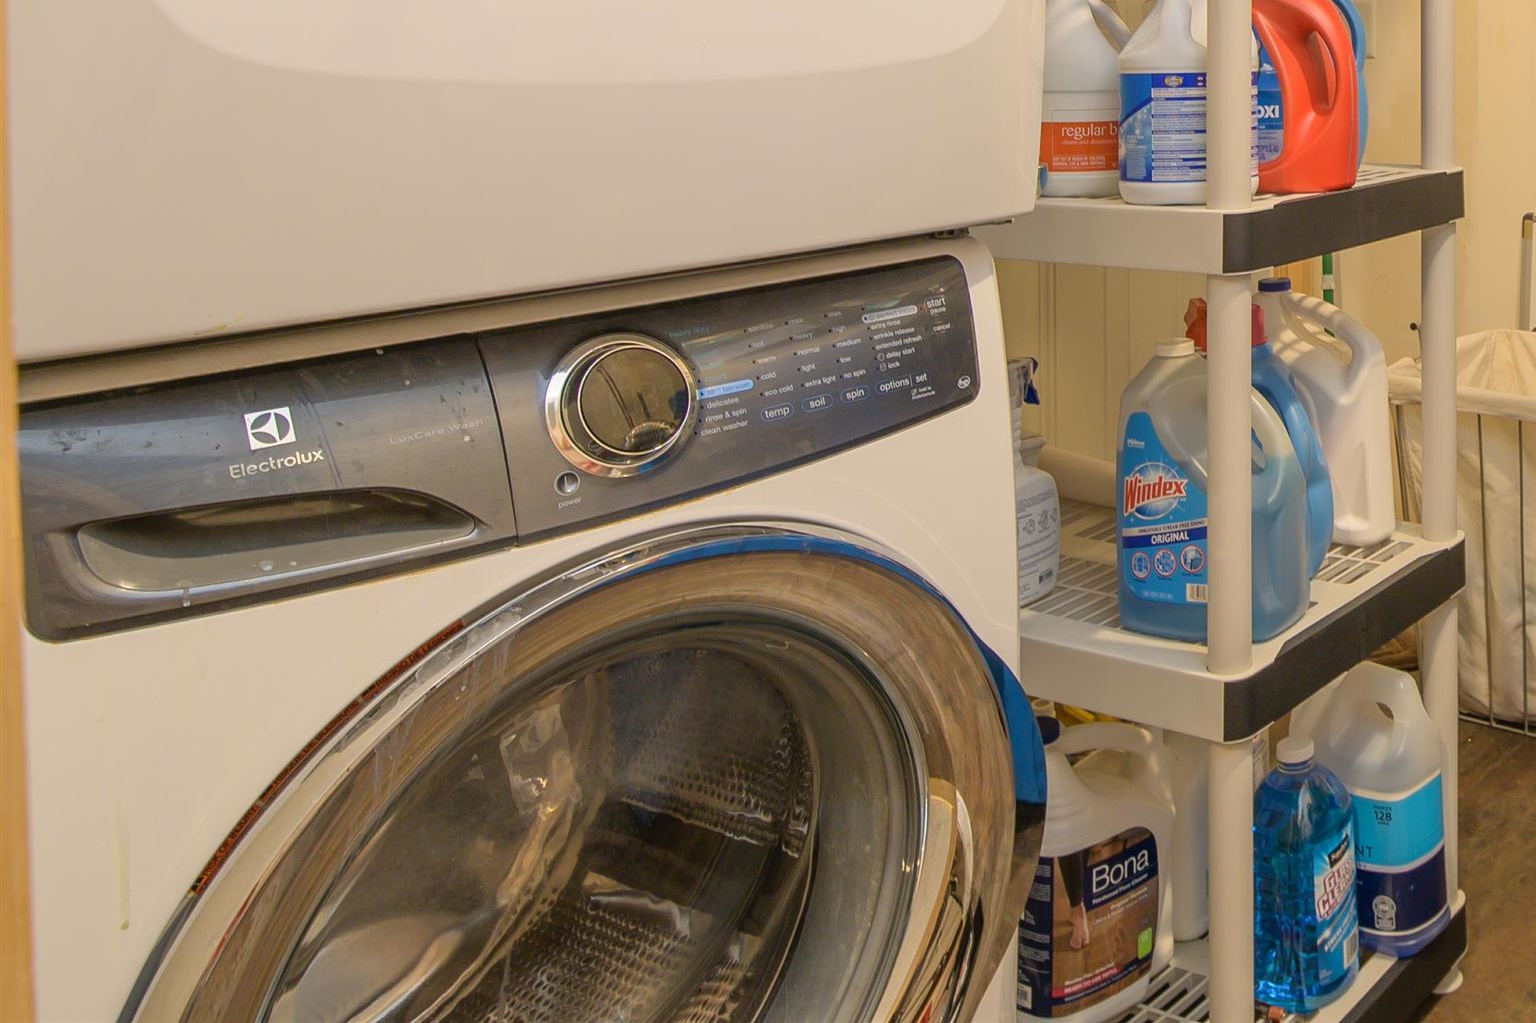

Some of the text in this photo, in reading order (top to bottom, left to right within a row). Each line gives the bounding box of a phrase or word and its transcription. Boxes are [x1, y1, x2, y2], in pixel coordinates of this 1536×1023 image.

[1061, 123, 1107, 140] regular
[926, 297, 946, 309] start
[873, 327, 915, 340] wrinkle release
[933, 323, 951, 332] cancel
[836, 337, 862, 349] medium
[876, 335, 923, 351] extended refresh
[798, 346, 820, 356] normal
[886, 347, 916, 360] delay start
[757, 355, 776, 364] warm
[840, 356, 851, 364] low
[887, 361, 900, 370] lock
[801, 363, 816, 373] light
[853, 369, 867, 379] spin
[761, 372, 777, 381] cold
[804, 375, 837, 388] extra light
[879, 378, 910, 393] options
[915, 373, 928, 383] set
[764, 385, 794, 398] eco cold
[846, 387, 866, 400] spin
[706, 395, 740, 410] delicates
[809, 397, 826, 409] soil
[705, 413, 724, 423] rinse
[731, 408, 748, 420] spin
[765, 405, 790, 420] temp
[448, 418, 485, 436] Wash
[701, 419, 749, 437] clean washer
[228, 448, 325, 479] Electrolux
[1124, 474, 1188, 516] Windex
[558, 495, 583, 509] power
[1151, 531, 1189, 544] ORIGINAL
[1374, 810, 1393, 822] 128
[1092, 849, 1150, 894] Bona
